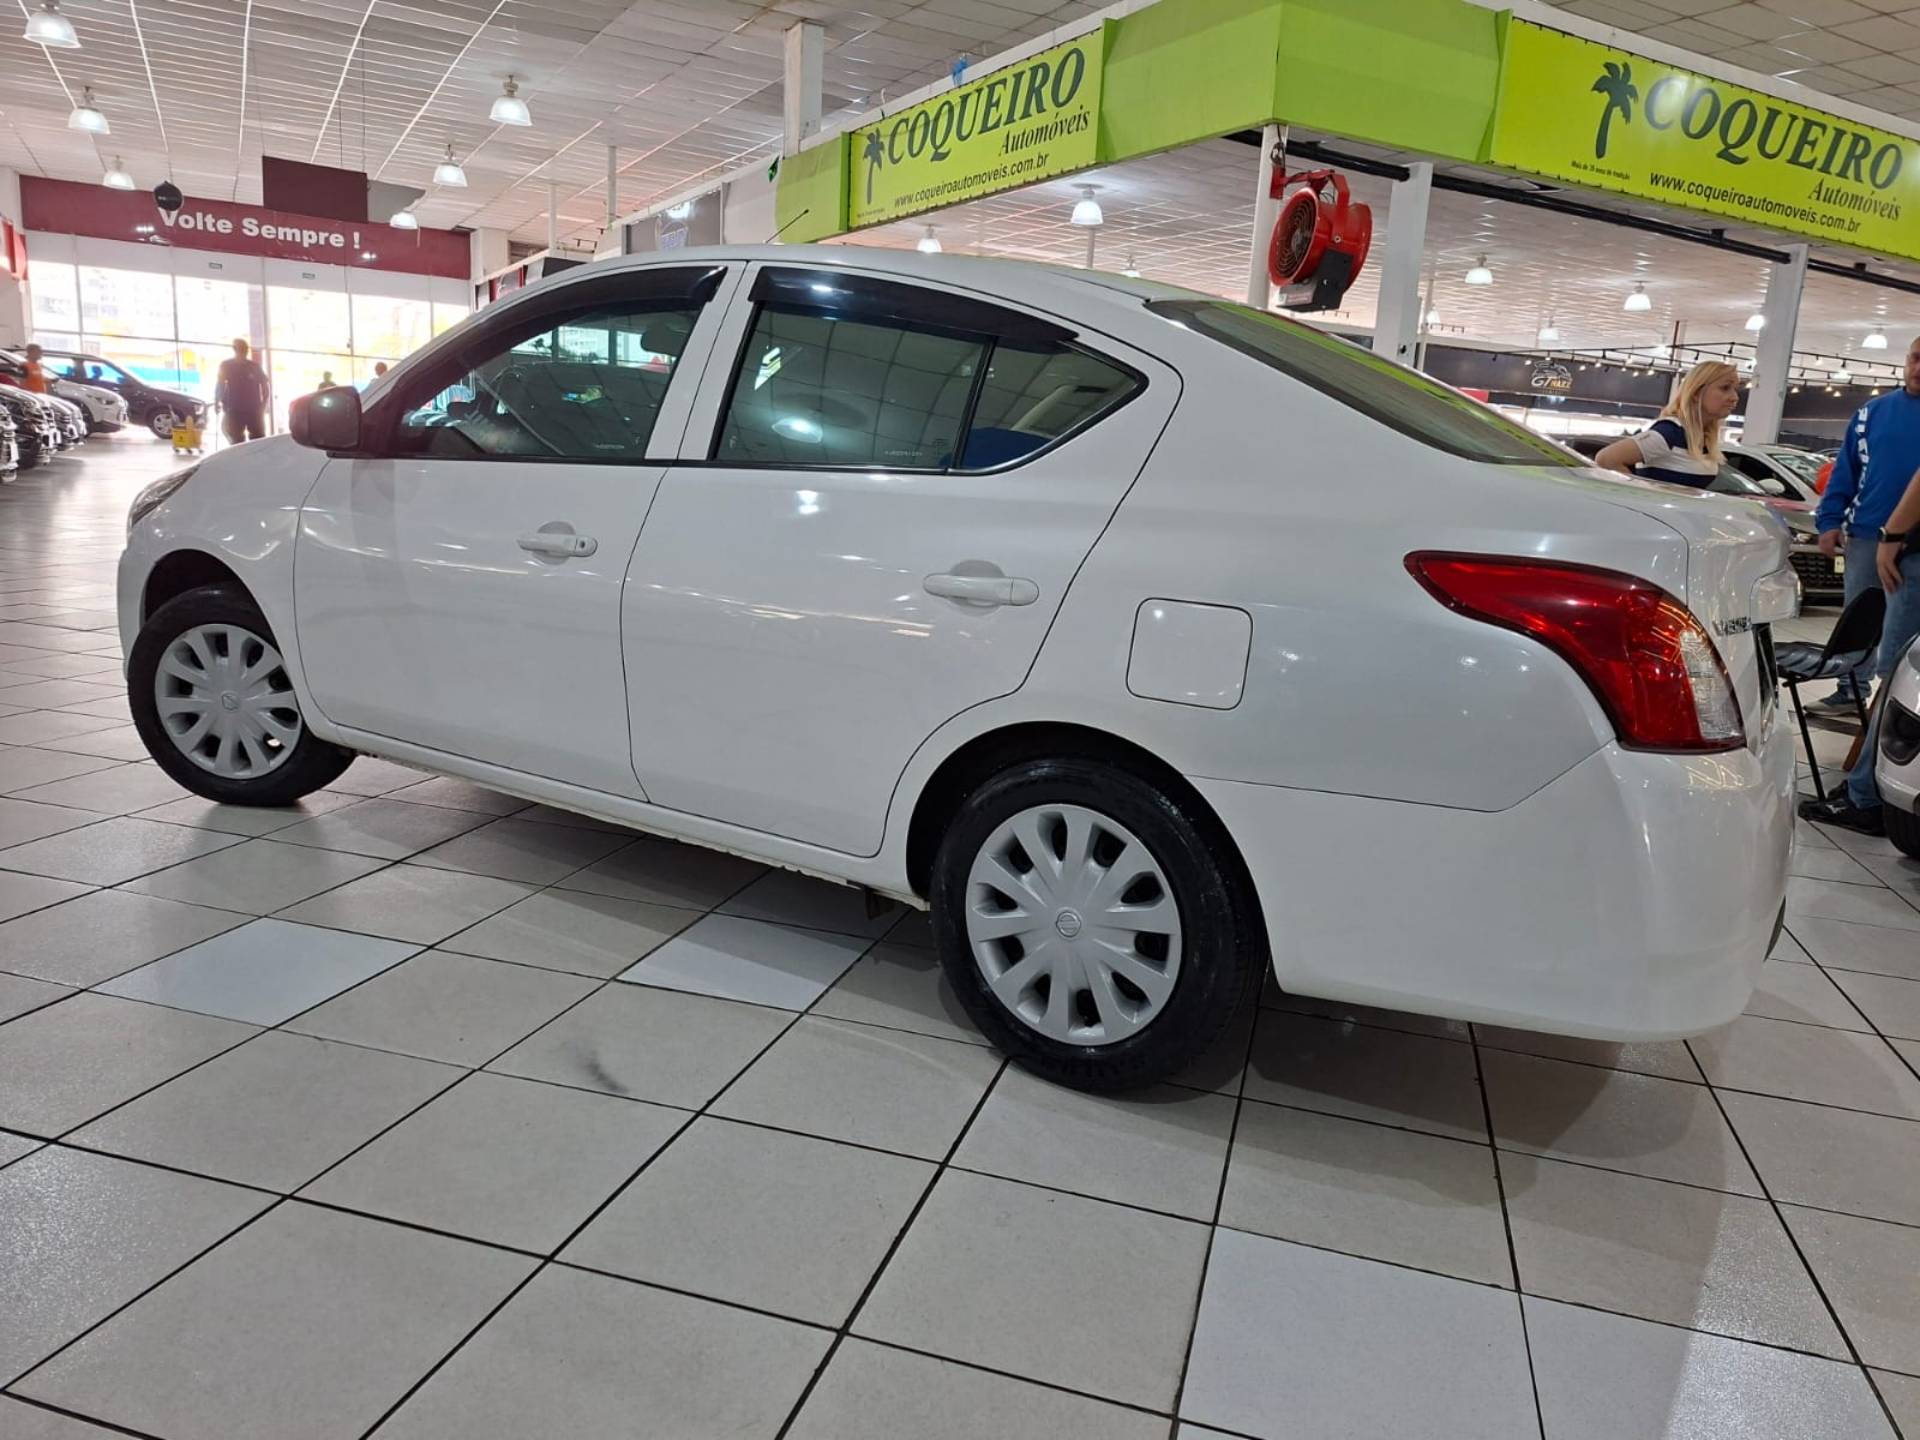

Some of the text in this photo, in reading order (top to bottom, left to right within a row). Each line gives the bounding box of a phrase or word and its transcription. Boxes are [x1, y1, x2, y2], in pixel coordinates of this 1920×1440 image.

[887, 47, 1085, 165] COQUEIRO
[999, 104, 1091, 157] Automóveis
[1644, 76, 1903, 190] COQUEIRO
[894, 152, 1050, 208] www.coqueiroautomoveis.com.br
[1650, 172, 1861, 233] www.coqueiroautomoveis.com.br
[1808, 178, 1901, 222] Automóveis
[158, 207, 233, 234] Volte
[242, 217, 345, 248] Sempre
